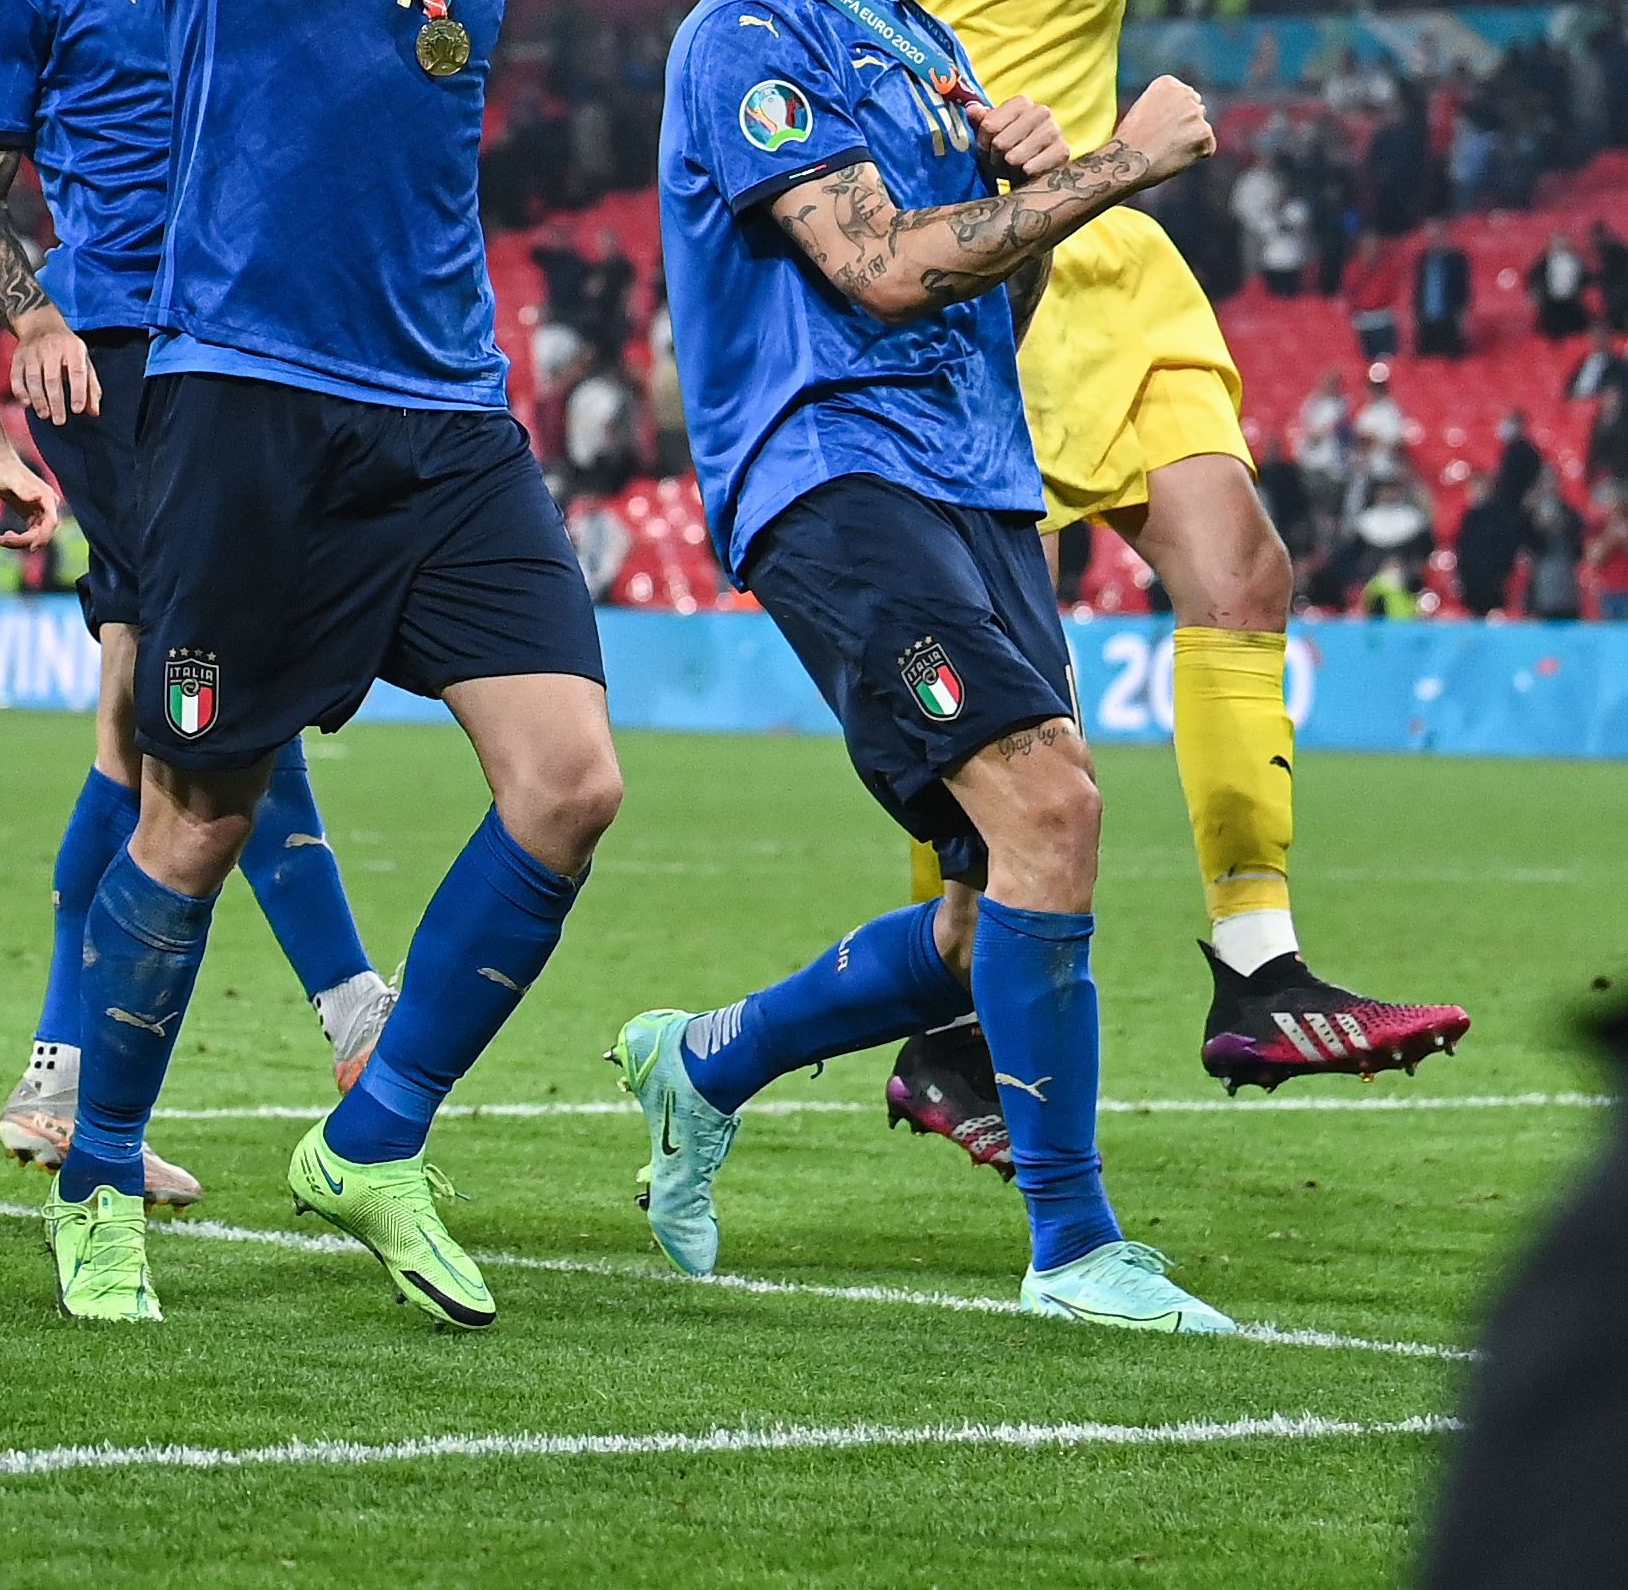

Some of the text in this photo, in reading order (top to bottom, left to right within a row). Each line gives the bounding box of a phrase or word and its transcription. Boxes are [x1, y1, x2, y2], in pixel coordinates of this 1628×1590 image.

[858, 8, 895, 40] EURO
[891, 34, 926, 66] 2020
[169, 666, 214, 682] ITALIA
[907, 650, 942, 682] ITALIA
[998, 732, 1034, 761] Day
[1037, 722, 1058, 747] by
